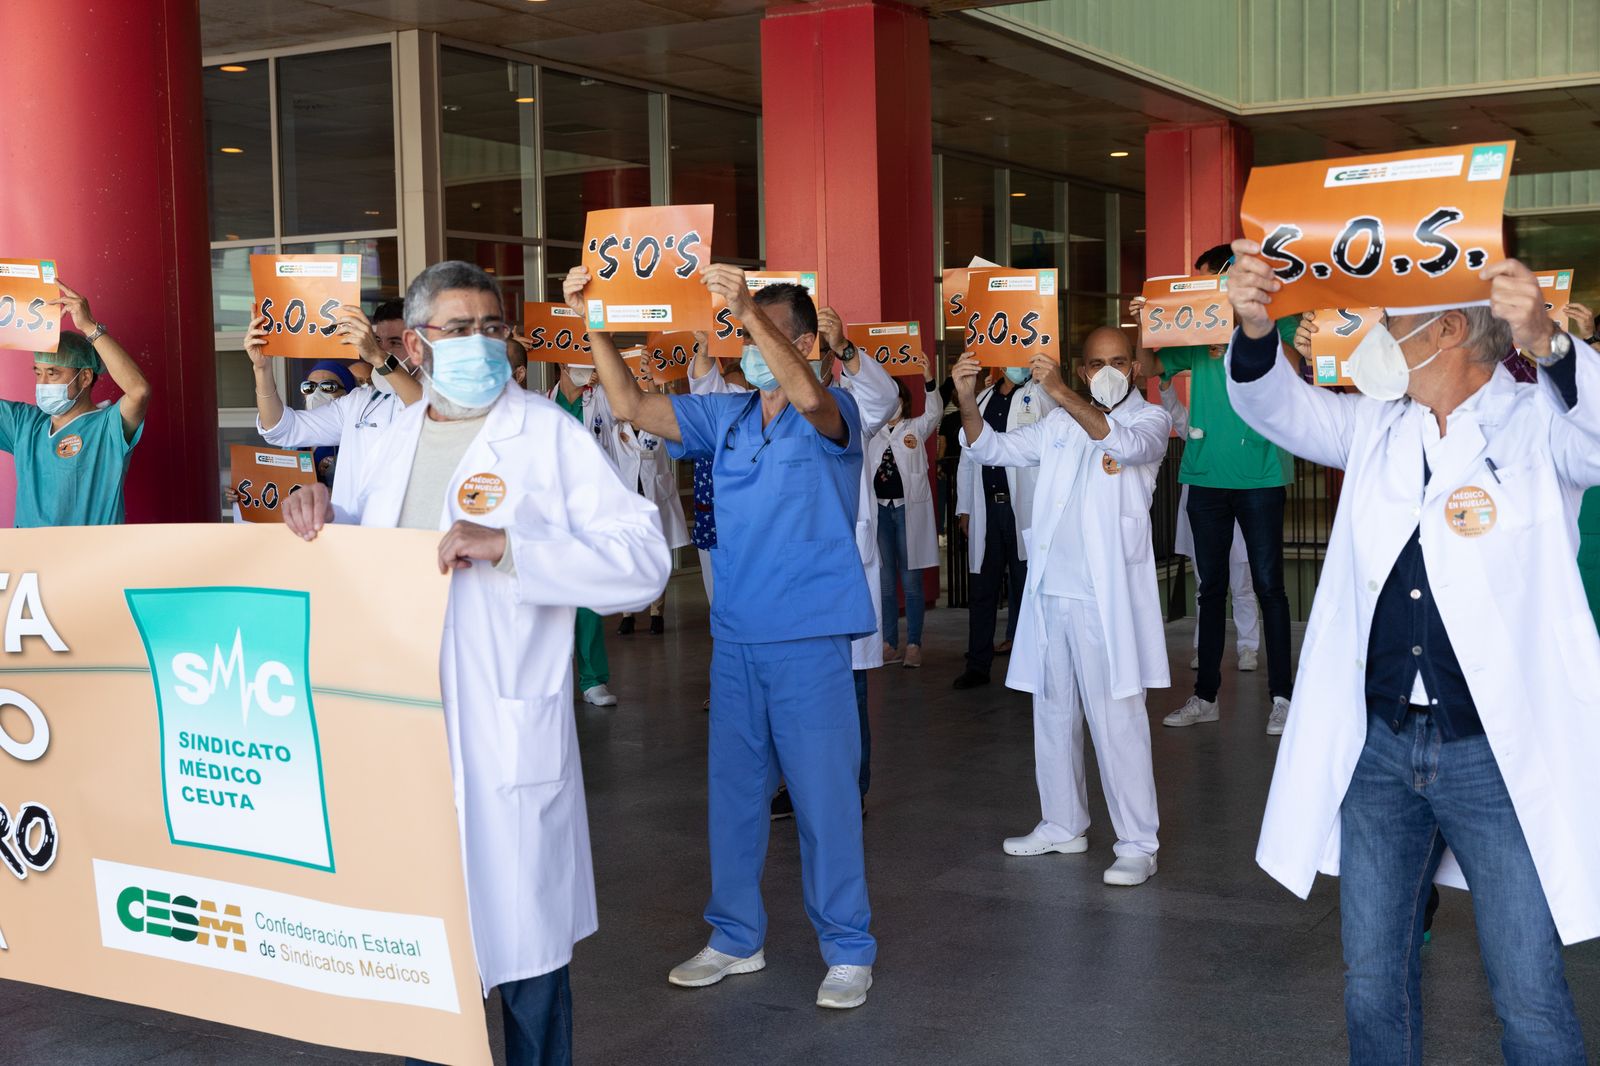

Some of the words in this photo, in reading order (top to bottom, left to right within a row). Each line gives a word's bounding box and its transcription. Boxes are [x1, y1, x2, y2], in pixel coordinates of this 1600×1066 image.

[1261, 206, 1489, 284] S.O.S.
[965, 310, 1052, 349] S.O.S.
[1149, 303, 1229, 334] S.O.S.
[1448, 502, 1459, 510] EN
[1459, 499, 1491, 509] HUELGA
[1452, 490, 1485, 500] MÉDICO
[171, 625, 297, 729] SMC
[178, 731, 292, 763] SINDICATO
[179, 758, 262, 785] MÉDICO
[181, 786, 255, 811] CEUTA
[116, 886, 247, 953] CESM
[254, 911, 357, 950] Confederación
[363, 933, 421, 958] Estatal
[259, 940, 276, 958] de
[280, 943, 355, 976] Sindicatos
[359, 959, 430, 985] Médicos
